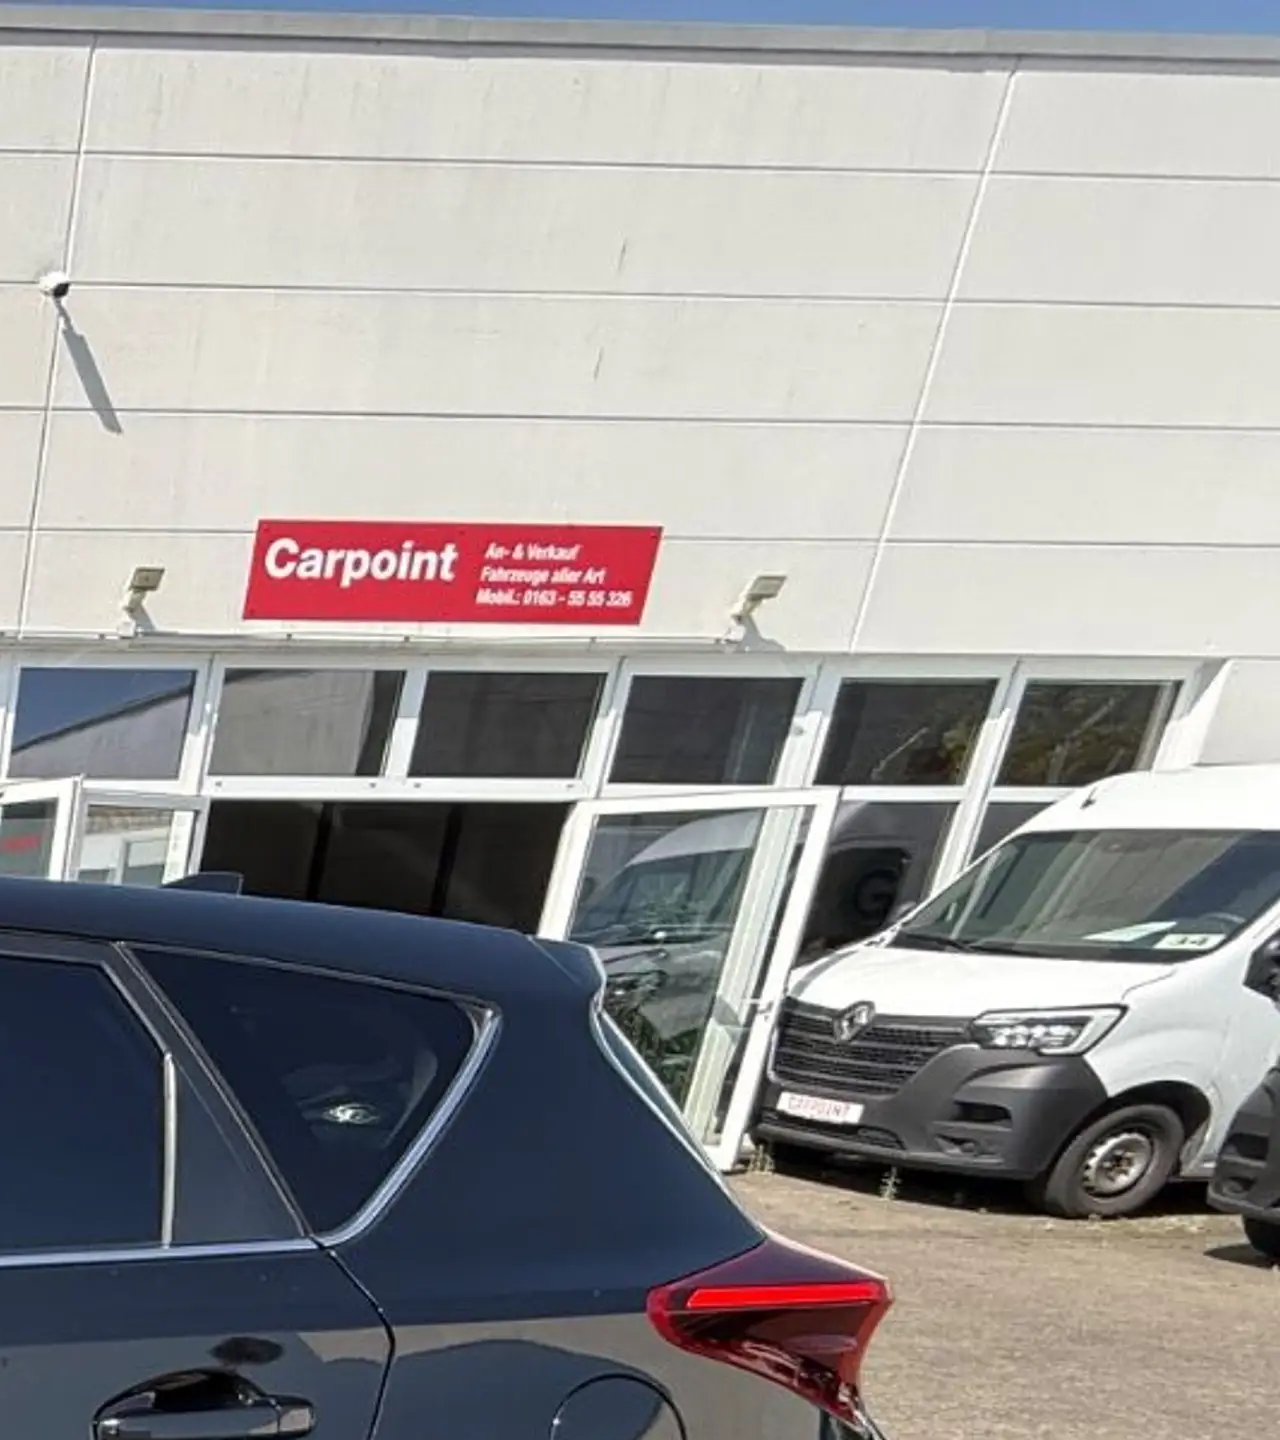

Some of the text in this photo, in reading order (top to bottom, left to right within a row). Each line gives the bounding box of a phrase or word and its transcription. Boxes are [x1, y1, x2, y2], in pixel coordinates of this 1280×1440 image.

[264, 536, 459, 589] Carpoint
[484, 542, 583, 561] An- & Verkauf
[480, 565, 606, 587] Fahrzeuge aller Art
